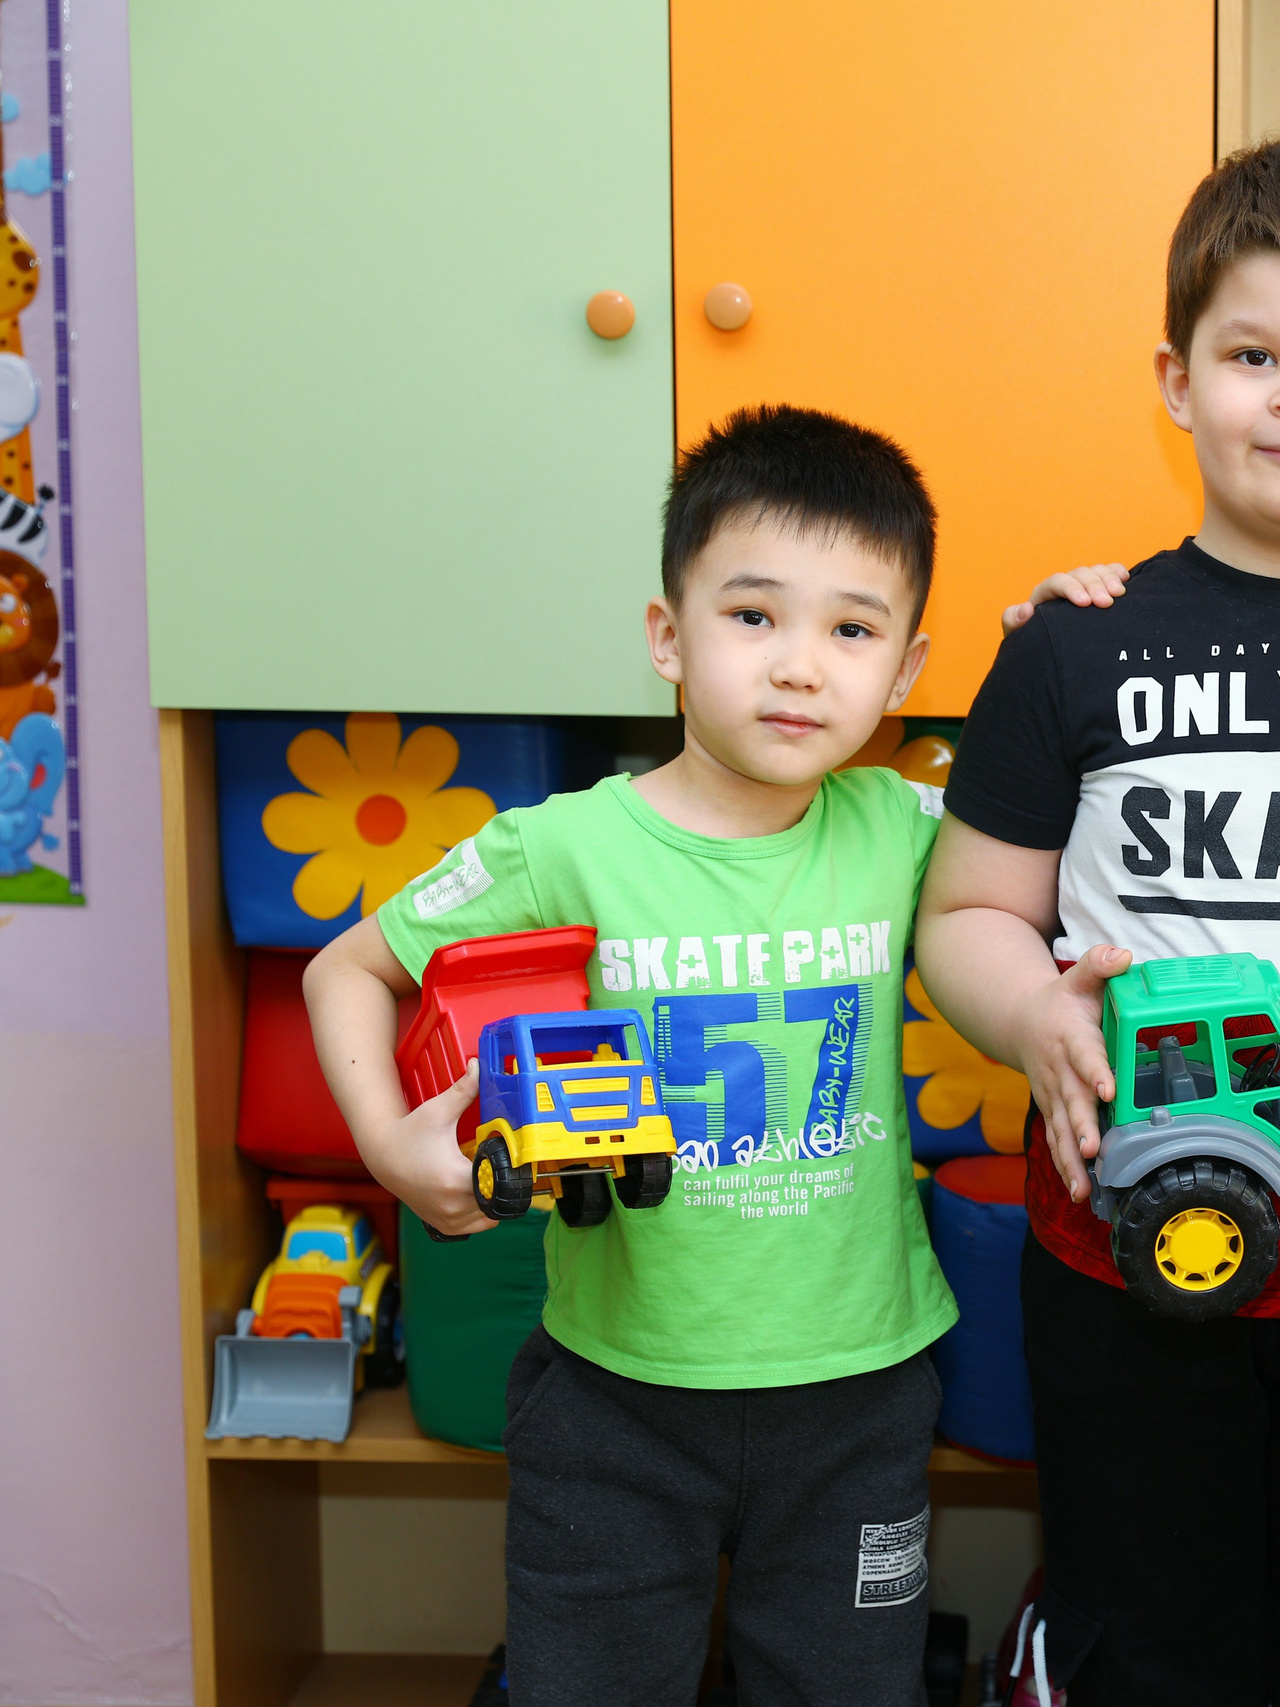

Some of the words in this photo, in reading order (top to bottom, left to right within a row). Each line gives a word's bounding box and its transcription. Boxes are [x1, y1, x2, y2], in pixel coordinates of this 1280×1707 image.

[1118, 646, 1175, 662] ALL
[1211, 642, 1271, 657] DAY
[599, 933, 771, 992] SKATE
[782, 920, 891, 984] PARK
[652, 983, 873, 1168] 57
[684, 1178, 711, 1191] can
[715, 1174, 749, 1190] fulfil
[753, 1173, 785, 1190] your
[789, 1169, 841, 1184] dreams
[844, 1163, 854, 1179] of
[684, 1191, 735, 1208] sailing
[739, 1189, 779, 1205] along
[784, 1186, 808, 1200] the
[813, 1180, 854, 1199] Pacific
[740, 1205, 764, 1220] the
[768, 1201, 809, 1217] world
